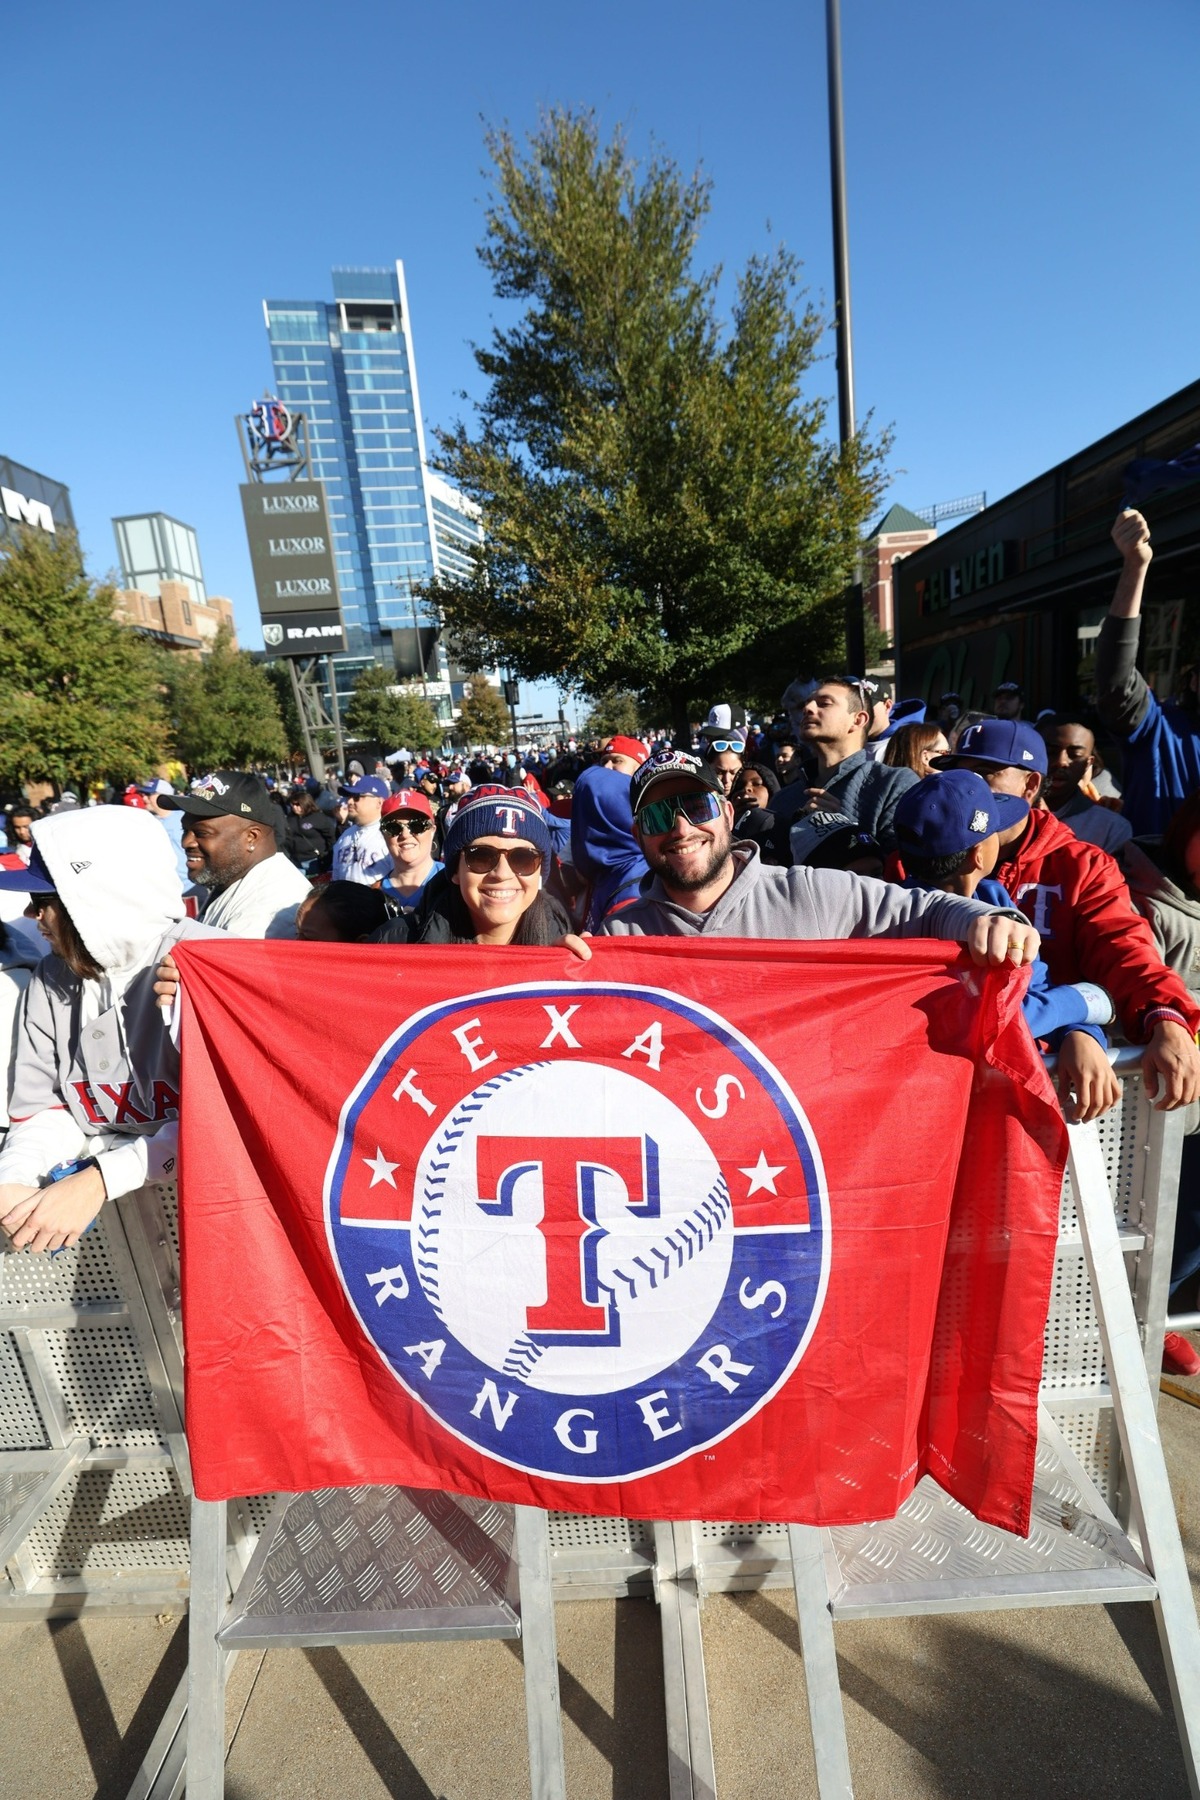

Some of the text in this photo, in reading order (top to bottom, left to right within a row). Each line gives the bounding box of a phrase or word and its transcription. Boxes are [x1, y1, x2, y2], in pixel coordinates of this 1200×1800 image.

[0, 486, 56, 533] M
[262, 495, 319, 510] LUXOR
[269, 537, 325, 553] LUXOR
[275, 578, 331, 593] LUXOR
[287, 625, 342, 638] RAM
[962, 725, 982, 749] T
[395, 790, 411, 806] T
[495, 806, 526, 836] T
[1017, 883, 1063, 937] T
[392, 1004, 746, 1119] TEXAS
[475, 1133, 661, 1348] T
[365, 1264, 787, 1454] RANGERS
